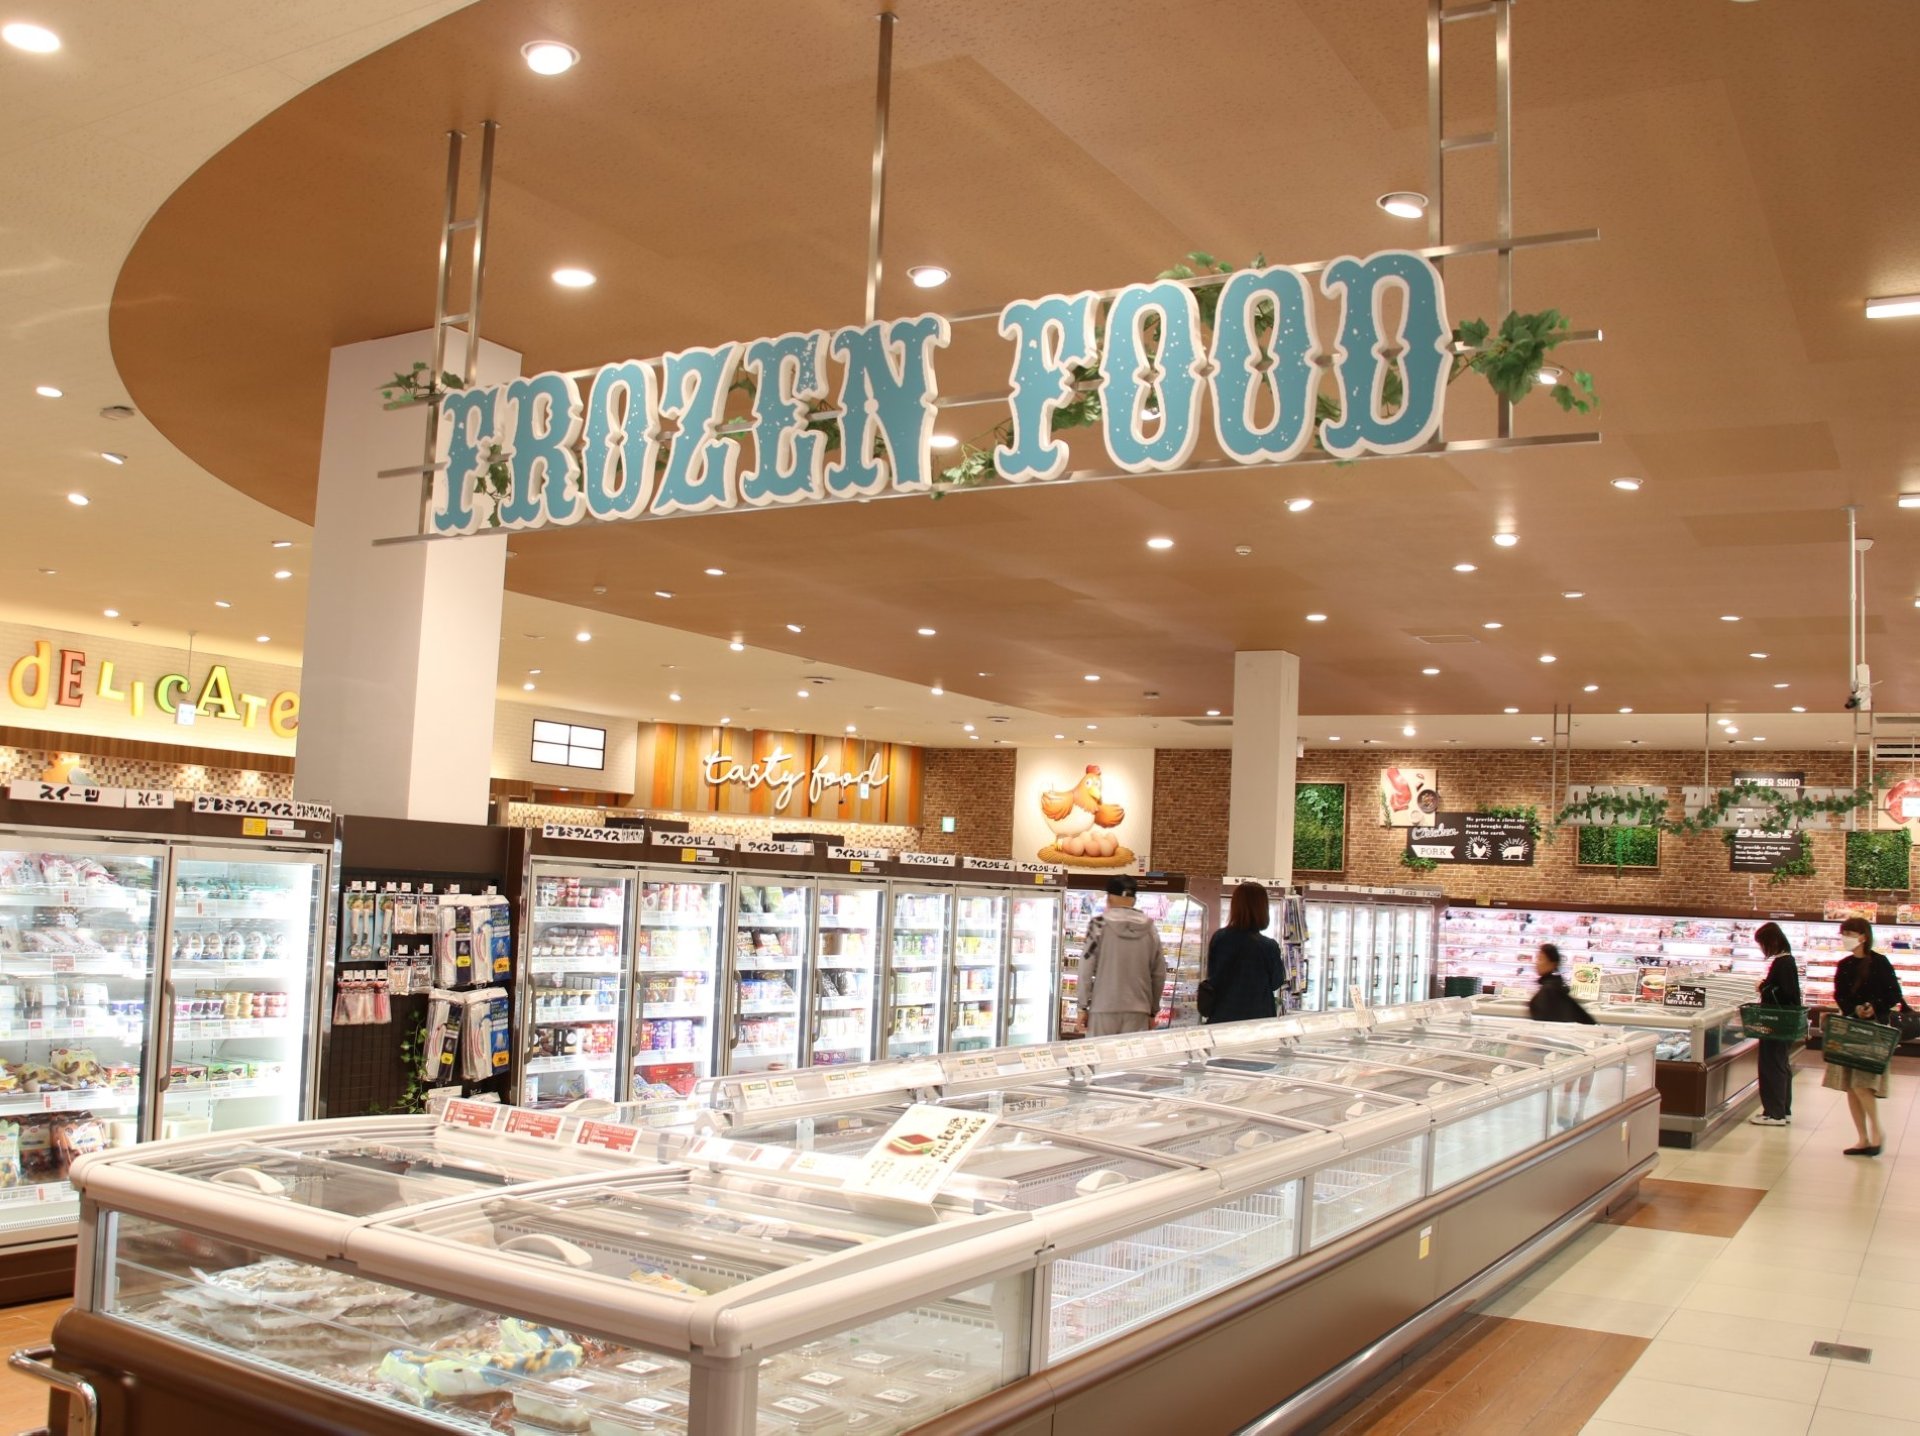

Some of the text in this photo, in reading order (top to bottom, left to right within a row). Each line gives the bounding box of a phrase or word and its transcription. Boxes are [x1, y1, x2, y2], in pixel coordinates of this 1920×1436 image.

[433, 249, 1454, 535] FROZEN FOOD
[703, 747, 889, 810] tasty food
[39, 784, 100, 802] スイーツ
[199, 797, 294, 816] プレミアムアイス
[545, 825, 620, 842] プレミアムアイス
[660, 833, 716, 846] アイスクリーム
[748, 841, 798, 853] アイスクリーム
[1420, 847, 1447, 856] PORK
[835, 848, 882, 859] アイスクリーム
[906, 853, 950, 865] アイスクリーム
[970, 859, 1010, 870] アイスクリーム
[1022, 863, 1059, 873] アイスクリーム
